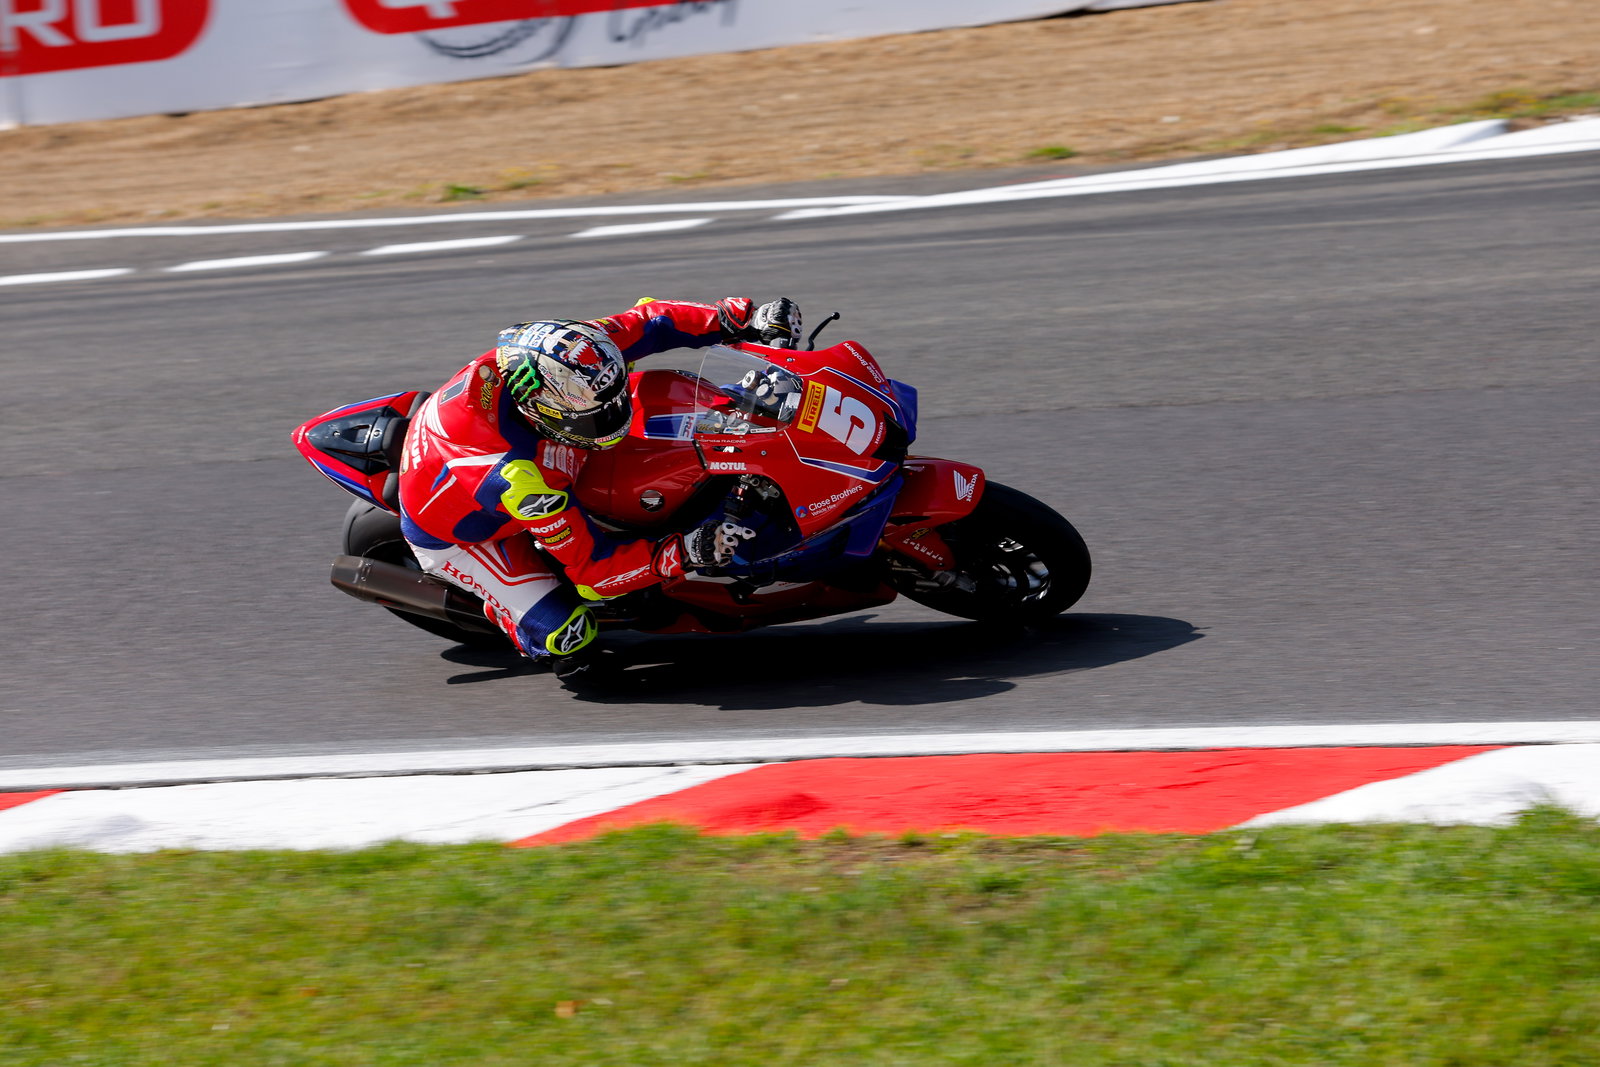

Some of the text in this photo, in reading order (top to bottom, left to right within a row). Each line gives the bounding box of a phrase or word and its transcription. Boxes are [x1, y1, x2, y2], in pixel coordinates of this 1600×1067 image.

[843, 343, 882, 384] Close Brothers
[802, 385, 823, 427] PIRELLI
[817, 386, 876, 455] 5
[875, 421, 884, 444] HONDA
[709, 462, 746, 471] MOTUL
[808, 484, 863, 511] Close Brothers
[966, 473, 978, 502] HONDA
[530, 517, 567, 533] MOTUL
[441, 561, 513, 621] HONDA
